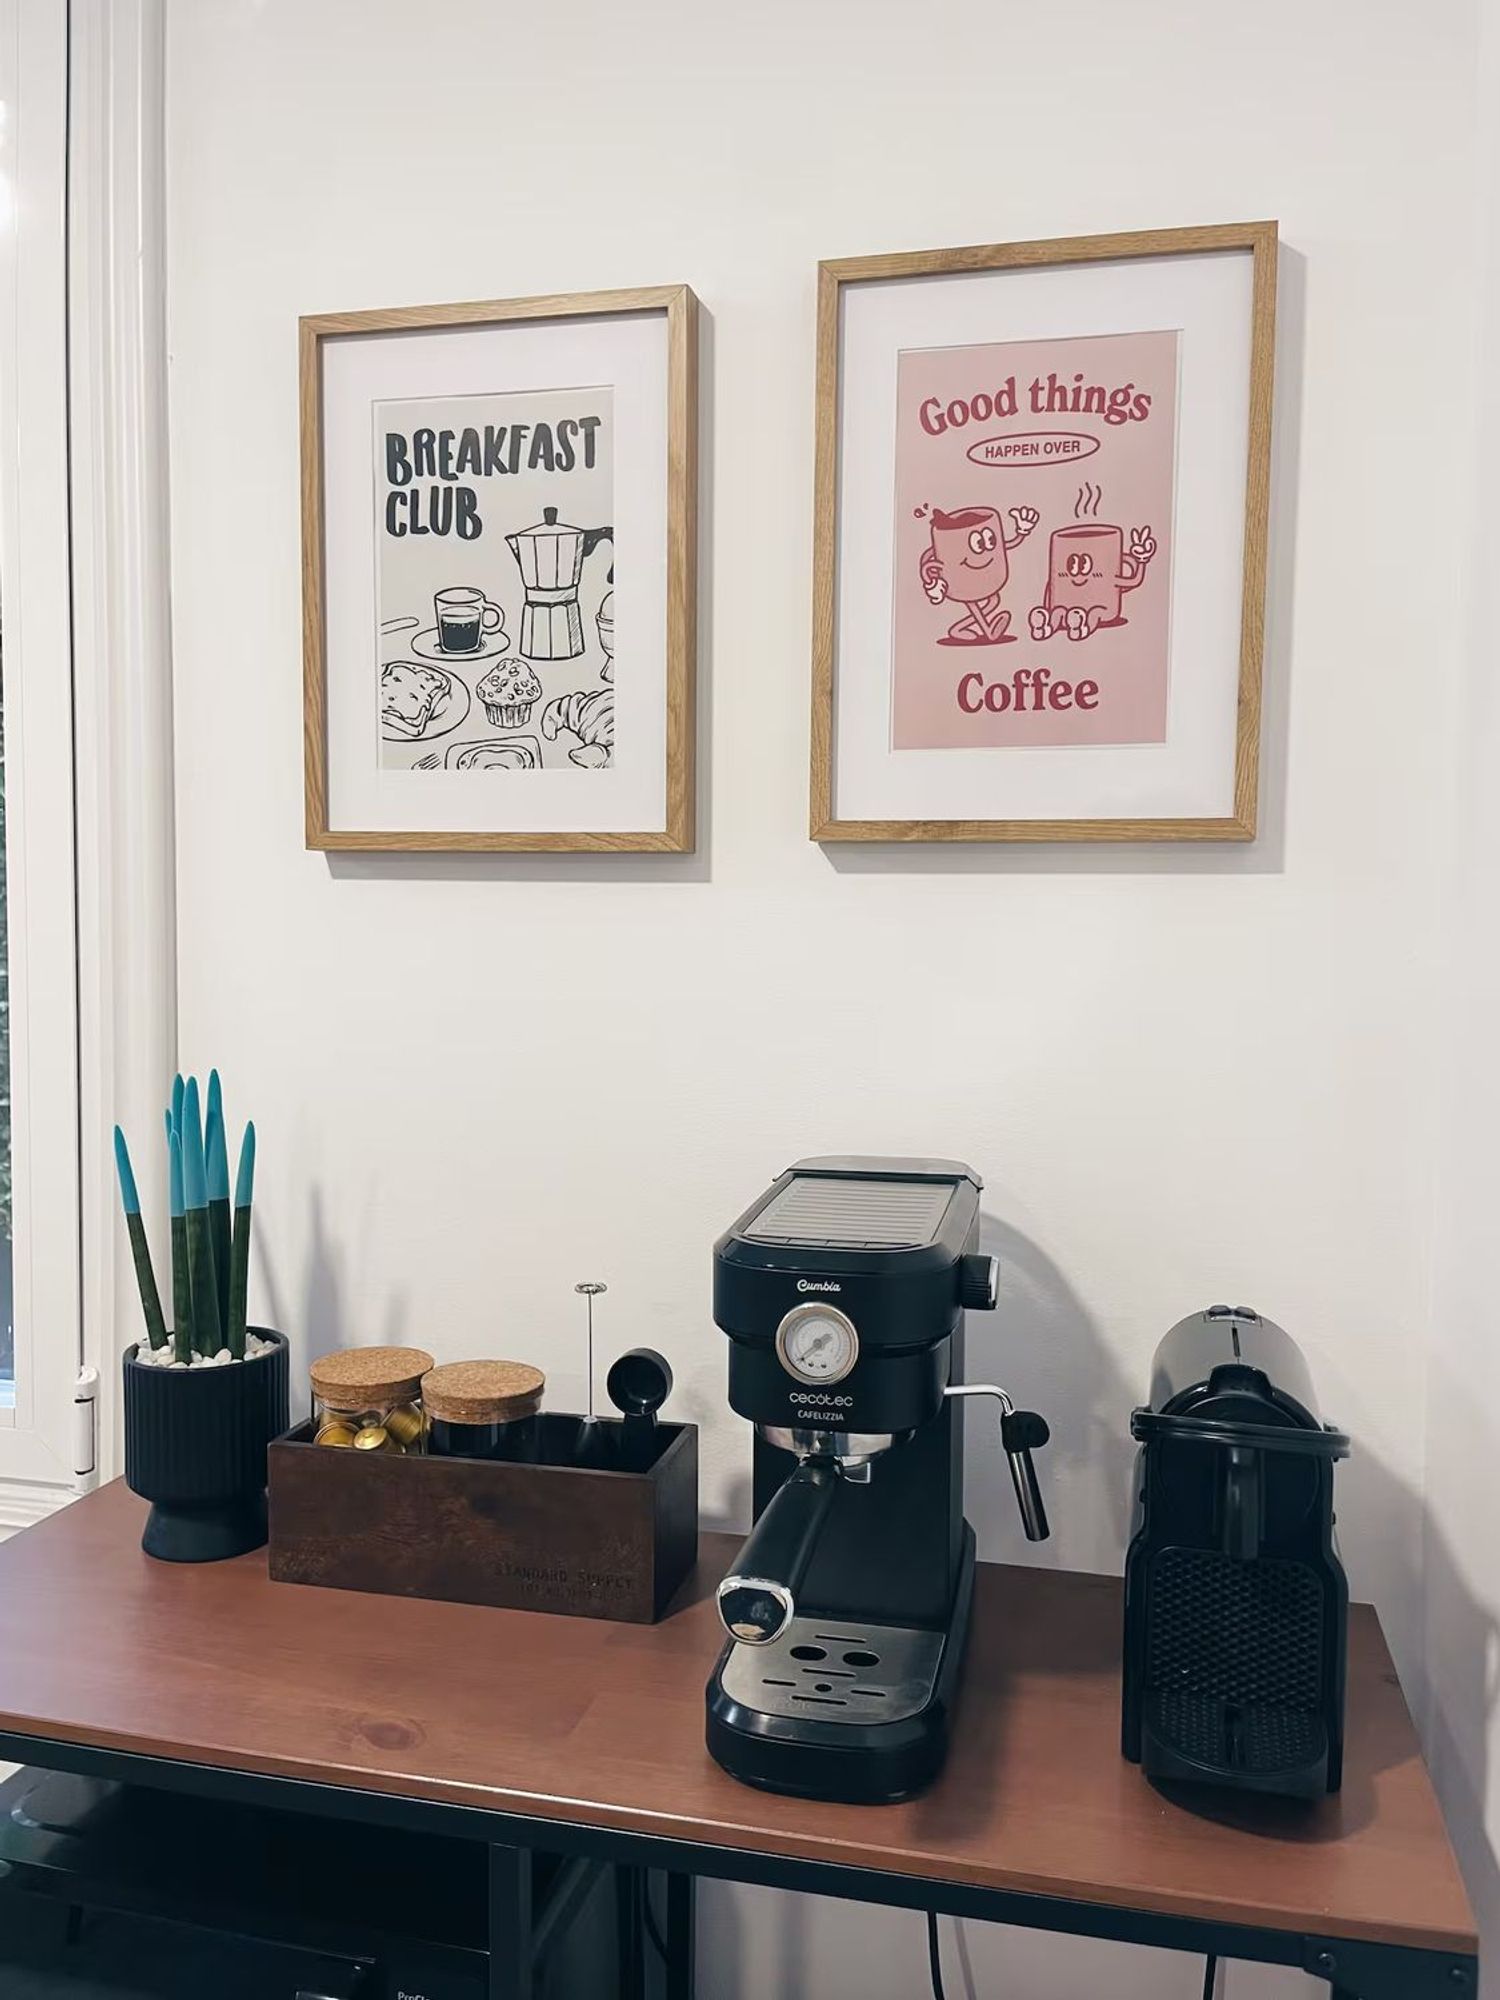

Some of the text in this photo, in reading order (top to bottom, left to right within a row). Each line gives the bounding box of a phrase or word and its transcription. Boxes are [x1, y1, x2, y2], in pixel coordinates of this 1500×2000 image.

[919, 373, 1152, 436] Good things
[385, 415, 602, 487] BREAKFAST
[984, 440, 1081, 459] HAPPEN OVER
[385, 485, 483, 541] CLUB
[957, 668, 1099, 714] Coffee
[797, 1279, 841, 1292] Cumbia
[789, 1392, 853, 1407] cecotec
[797, 1409, 845, 1422] CAFELIZZIA
